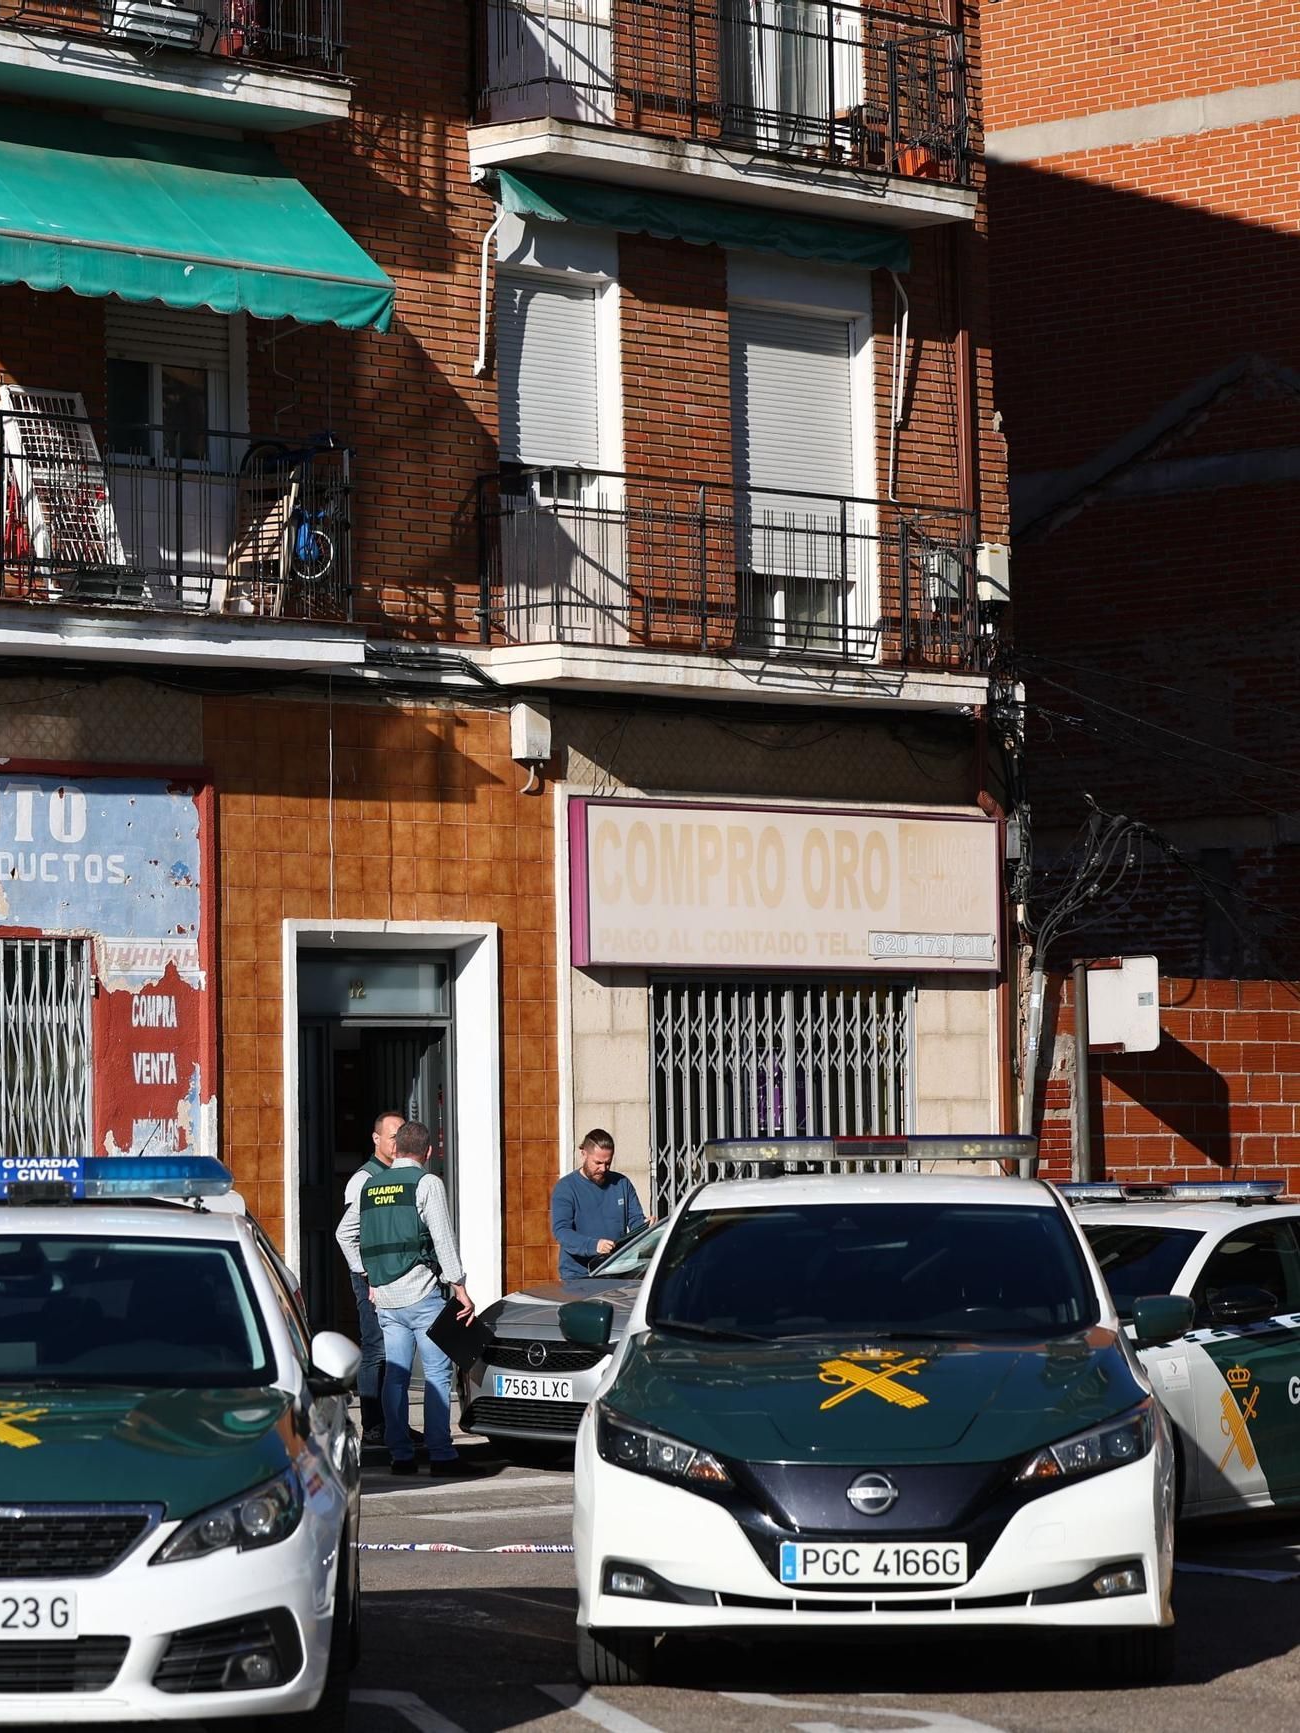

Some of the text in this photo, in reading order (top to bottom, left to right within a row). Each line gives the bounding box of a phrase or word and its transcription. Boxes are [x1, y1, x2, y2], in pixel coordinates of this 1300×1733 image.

[594, 819, 891, 912] COMPRO ORO
[598, 929, 660, 954] PAGO
[667, 929, 696, 954] AL
[703, 930, 810, 956] CONTADO
[873, 934, 908, 955] 620
[914, 935, 948, 955] 179
[955, 936, 988, 955] 818
[131, 995, 178, 1028] COMPRA
[132, 1053, 178, 1085] VENTA
[2, 1158, 79, 1169] GUARDIA
[16, 1169, 65, 1182] CIVIL
[367, 1184, 404, 1197] GUARDIA
[374, 1195, 396, 1206] CIVIL
[504, 1378, 538, 1396] 7563
[542, 1380, 570, 1399] LXC
[801, 1548, 861, 1576] PGC
[50, 1597, 70, 1629] G
